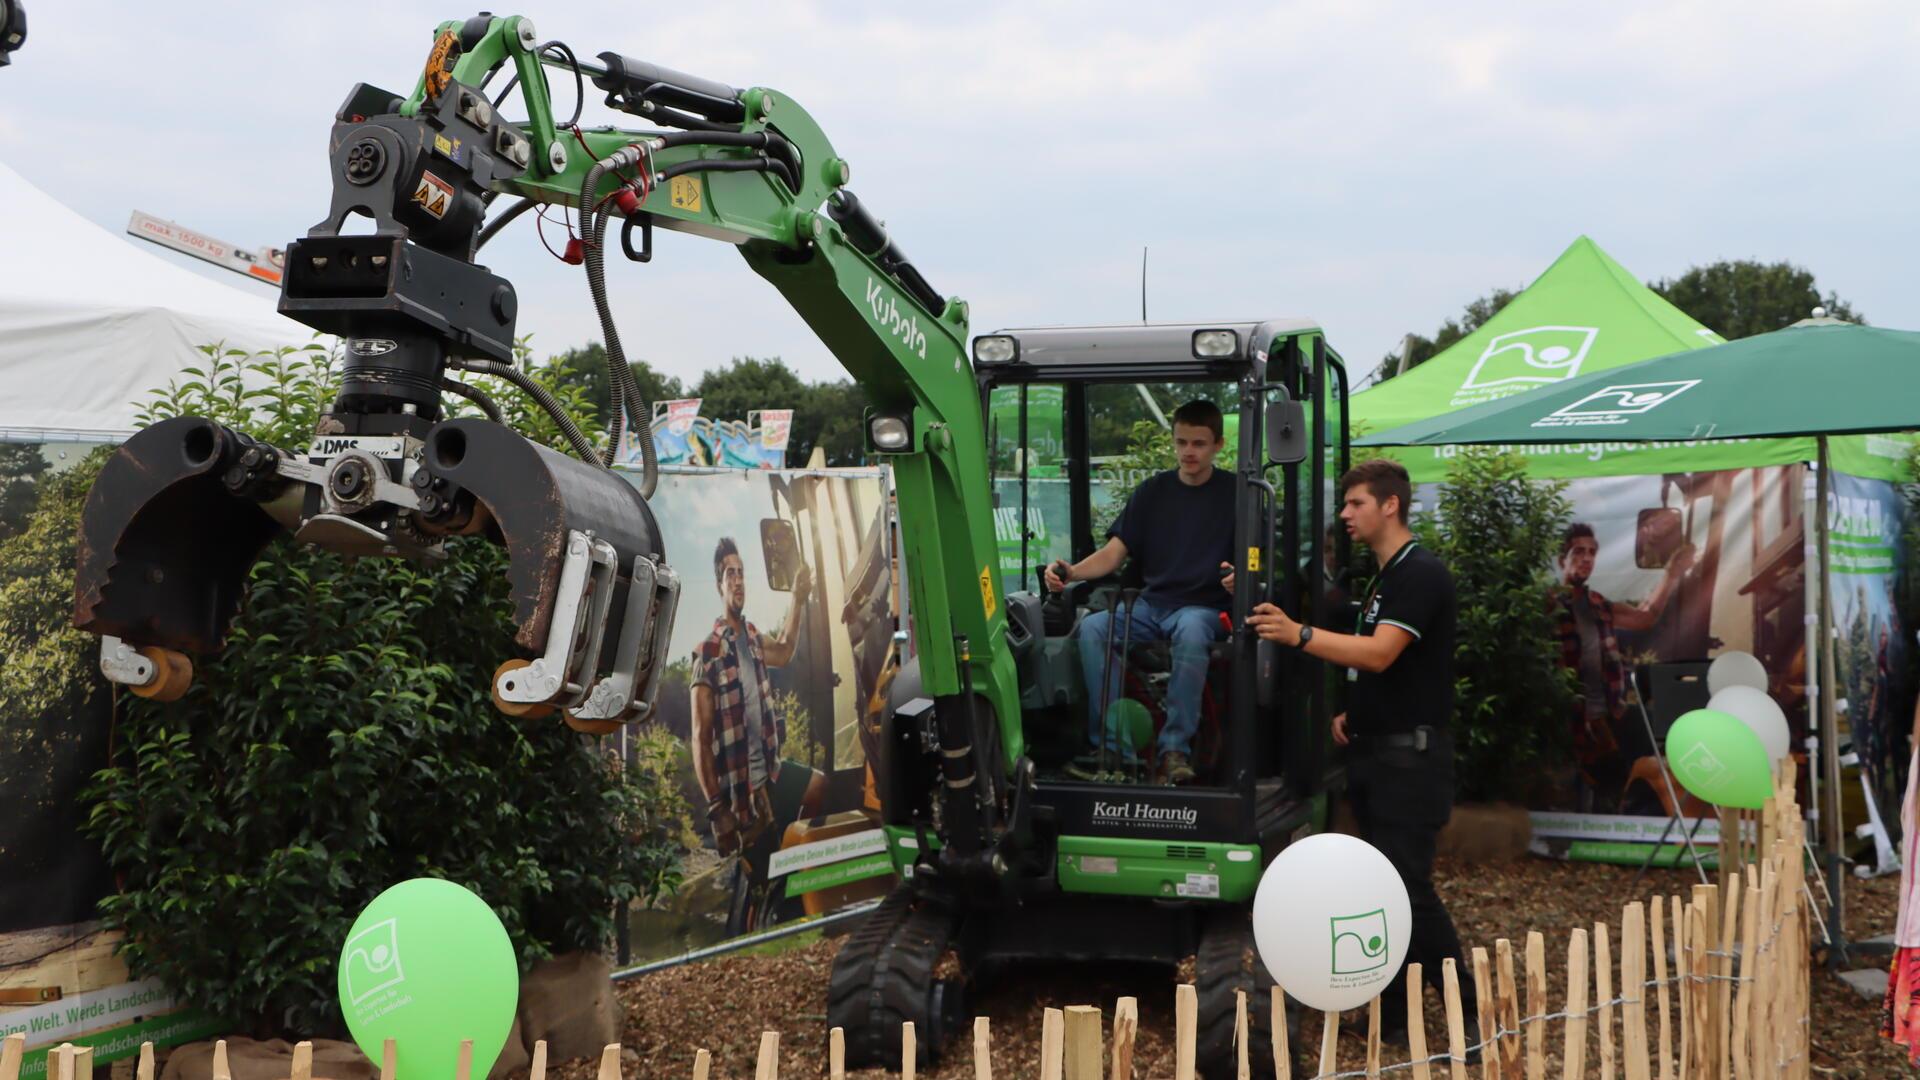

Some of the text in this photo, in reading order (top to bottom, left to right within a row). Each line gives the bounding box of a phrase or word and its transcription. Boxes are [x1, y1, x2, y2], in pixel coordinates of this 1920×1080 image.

[144, 221, 224, 256] max. 1500 kg
[866, 276, 926, 361] Kubota
[1093, 801, 1198, 825] Karl Hannig
[30, 1015, 64, 1034] Welt.
[66, 1002, 104, 1025] Werde
